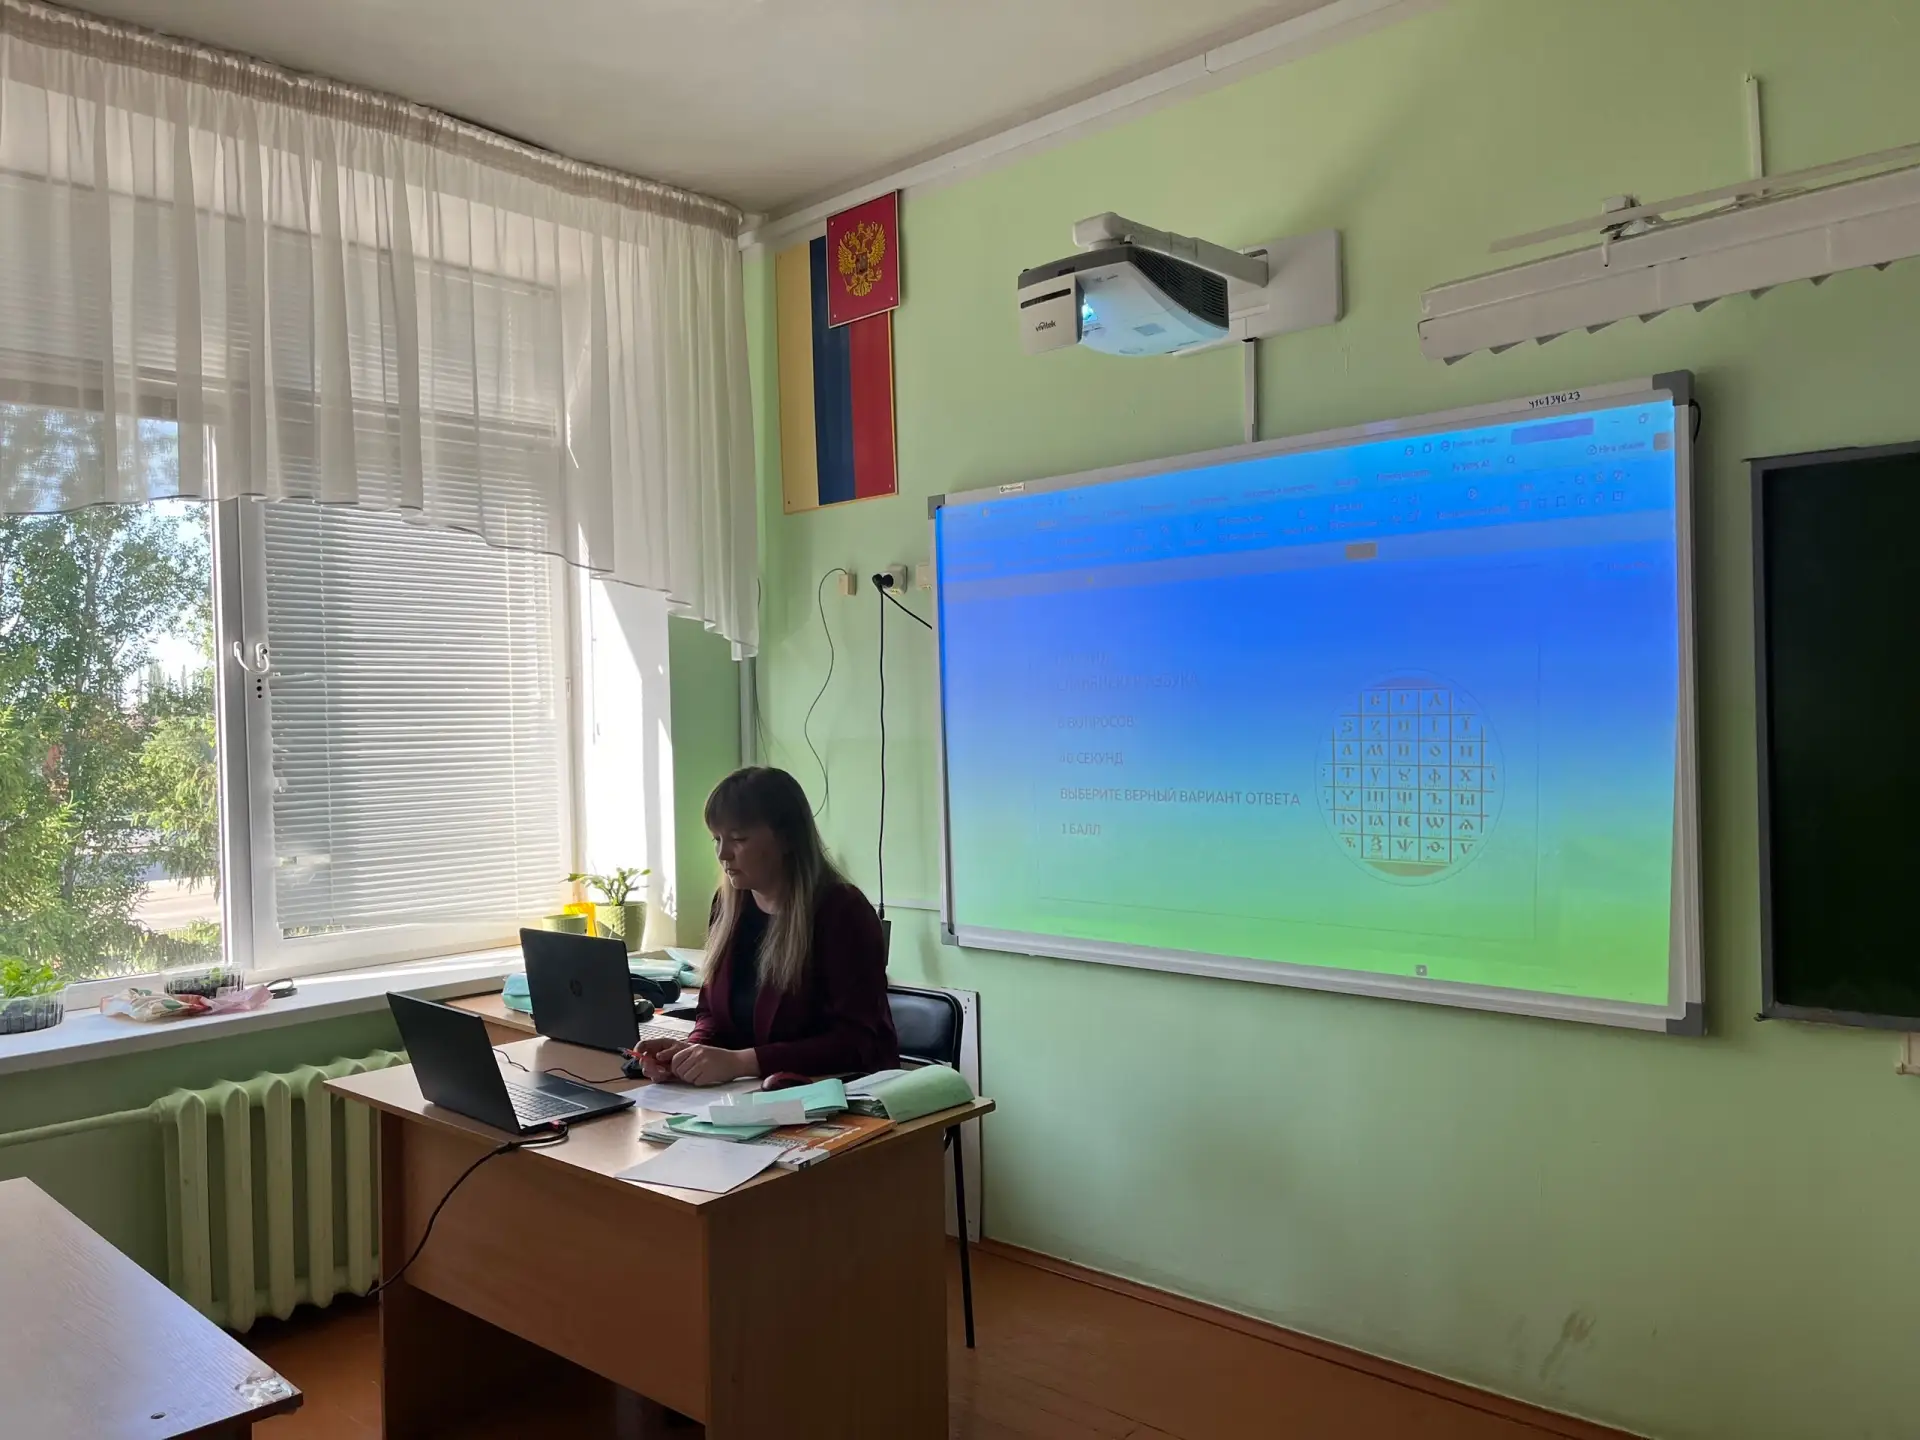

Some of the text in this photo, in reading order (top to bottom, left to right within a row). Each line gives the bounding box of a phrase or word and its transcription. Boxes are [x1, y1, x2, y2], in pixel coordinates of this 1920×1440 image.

[1068, 715, 1135, 730] ВОПРОСОВ
[1077, 751, 1124, 766] СЕКУНД
[1060, 787, 1300, 806] ВЫБЕРИТЕ ВЕРНЫЙ ВАРИАНТ ОТВЕТА
[1069, 823, 1101, 835] БАЛЛ
